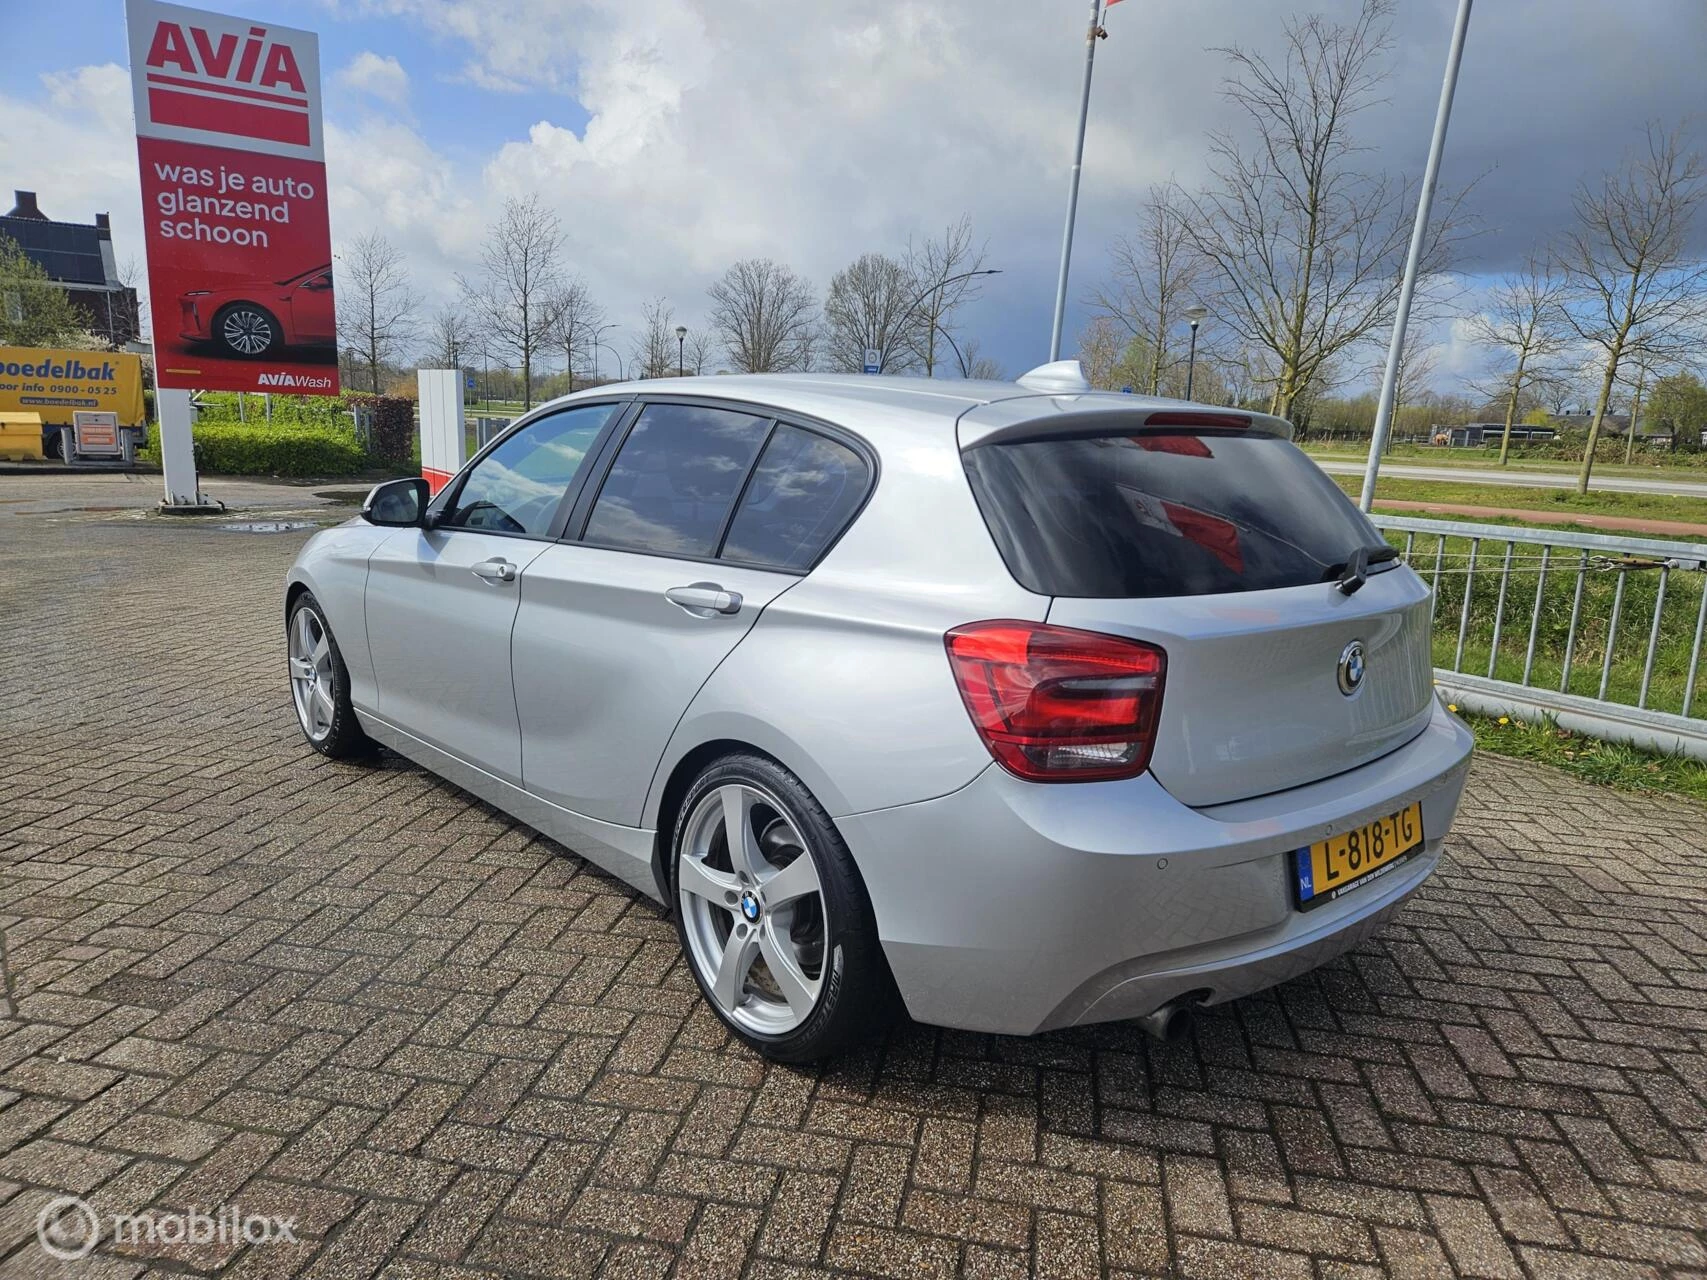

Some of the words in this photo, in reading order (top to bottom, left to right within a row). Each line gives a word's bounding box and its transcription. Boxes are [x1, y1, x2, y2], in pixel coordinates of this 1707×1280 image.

[154, 162, 214, 187] was
[218, 165, 245, 194] je
[252, 176, 314, 200] auto
[157, 187, 289, 223] glanzend
[160, 217, 268, 248] schoon
[22, 382, 45, 392] info
[1324, 808, 1412, 881] L-818-TG
[1300, 876, 1312, 890] NL
